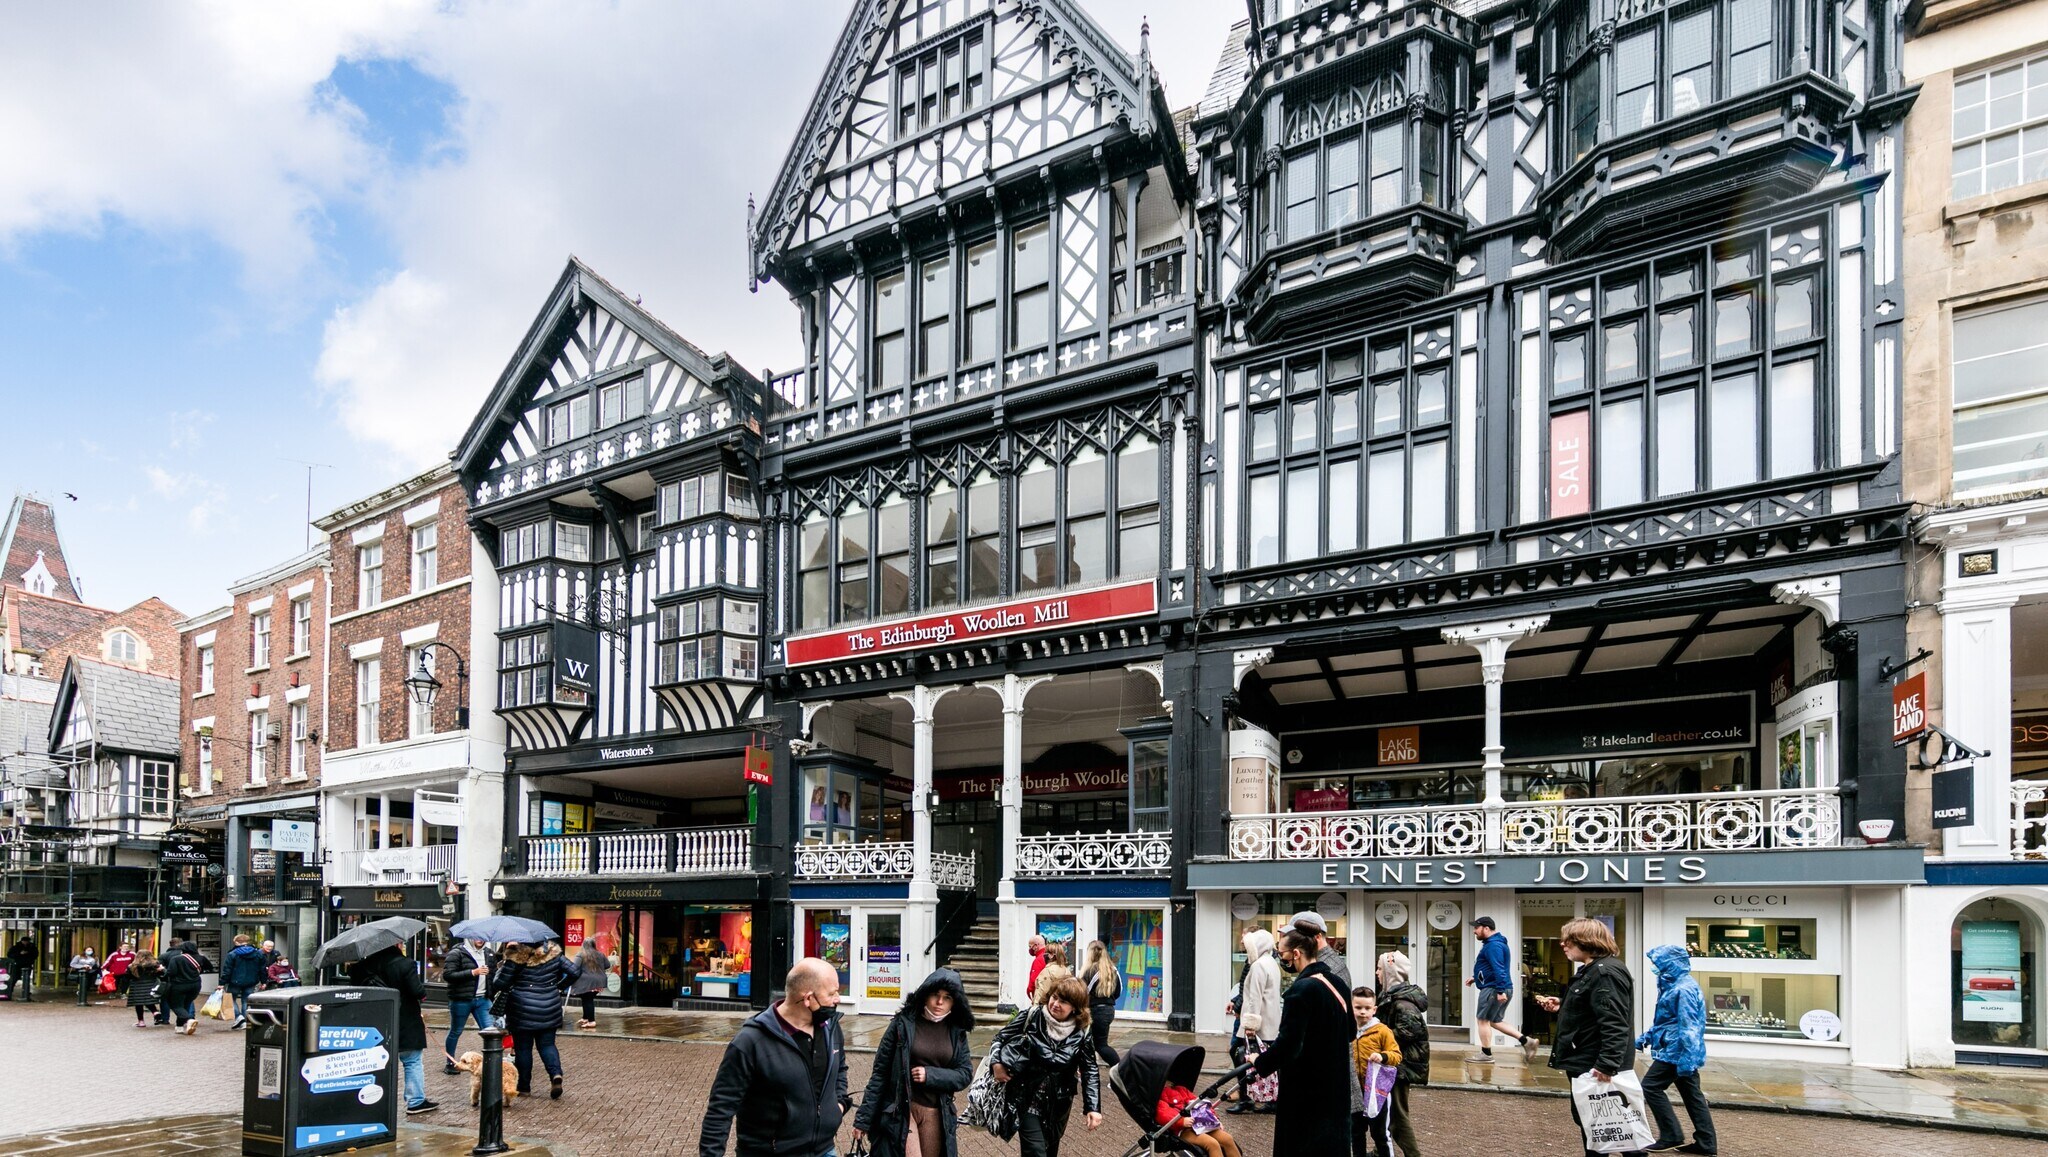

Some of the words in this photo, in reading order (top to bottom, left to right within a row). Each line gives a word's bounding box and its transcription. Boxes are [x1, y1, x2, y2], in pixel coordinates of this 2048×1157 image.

[1559, 437, 1580, 498] SALE
[848, 635, 875, 651] The
[880, 619, 955, 646] Edinburgh
[961, 610, 1026, 632] Woollen
[1033, 601, 1069, 623] Mill
[565, 657, 590, 679] W
[561, 674, 592, 688] Waterstone's
[1893, 692, 1920, 719] LAKE
[1893, 709, 1924, 736] LAND
[1601, 726, 1743, 747] lakelandleather.co.uk
[600, 744, 654, 760] Waterstone's
[1380, 738, 1412, 752] LAKE
[1380, 748, 1417, 762] LAND
[751, 771, 768, 783] EWM
[1236, 767, 1263, 775] Luxury
[959, 779, 987, 793] The
[1235, 776, 1264, 784] Leather
[613, 791, 668, 808] Waterstone's
[1934, 807, 1966, 819] KUONI
[280, 830, 310, 838] PAVERS
[1507, 825, 1519, 838] H
[1556, 827, 1568, 840] H
[1322, 860, 1497, 884] ERNEST
[1533, 857, 1708, 883] JONES
[374, 890, 403, 902] Loake
[608, 884, 662, 900] Accessorize
[1713, 895, 1787, 905] GUCCI
[868, 976, 901, 984] ENQUIRIES
[320, 1028, 368, 1040] arefully
[318, 1068, 347, 1079] traders
[349, 1063, 378, 1072] trading
[333, 1060, 354, 1068] keep
[1590, 1098, 1623, 1118] DROPS
[1622, 1110, 1641, 1120] 2020
[1619, 1134, 1633, 1142] DAY
